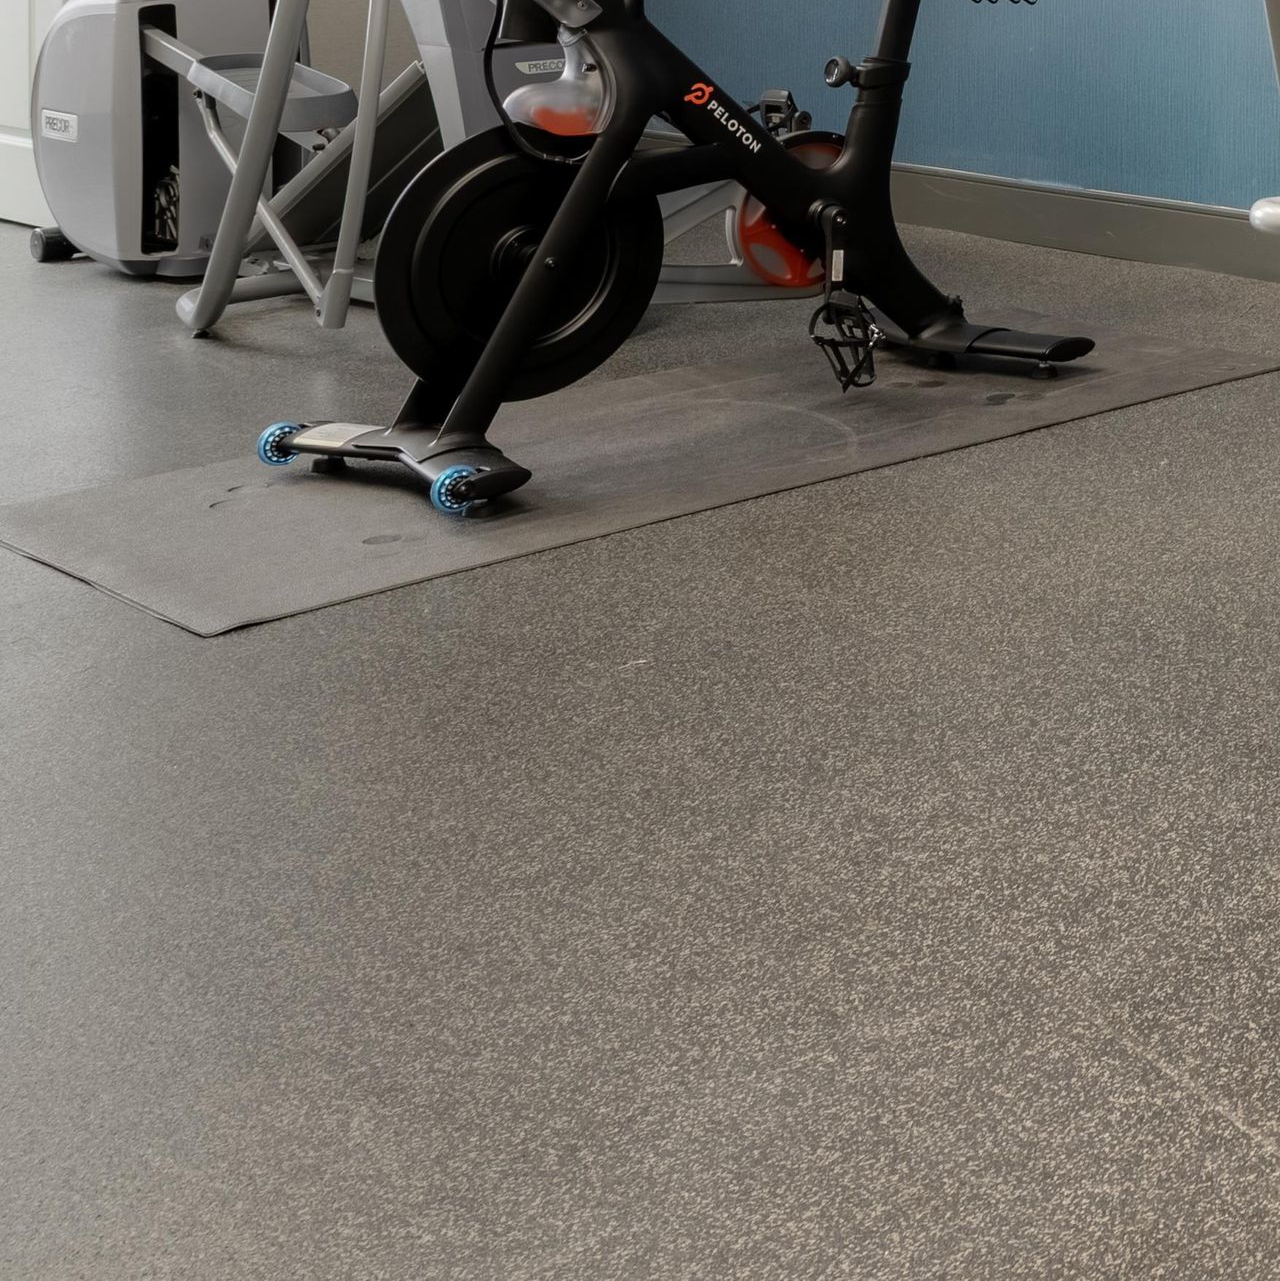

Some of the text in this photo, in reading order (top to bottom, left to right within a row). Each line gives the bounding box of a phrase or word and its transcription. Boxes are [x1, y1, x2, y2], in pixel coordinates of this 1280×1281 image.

[527, 60, 564, 73] PRECO
[45, 116, 71, 132] PRECOR
[707, 100, 762, 153] PELOTON
